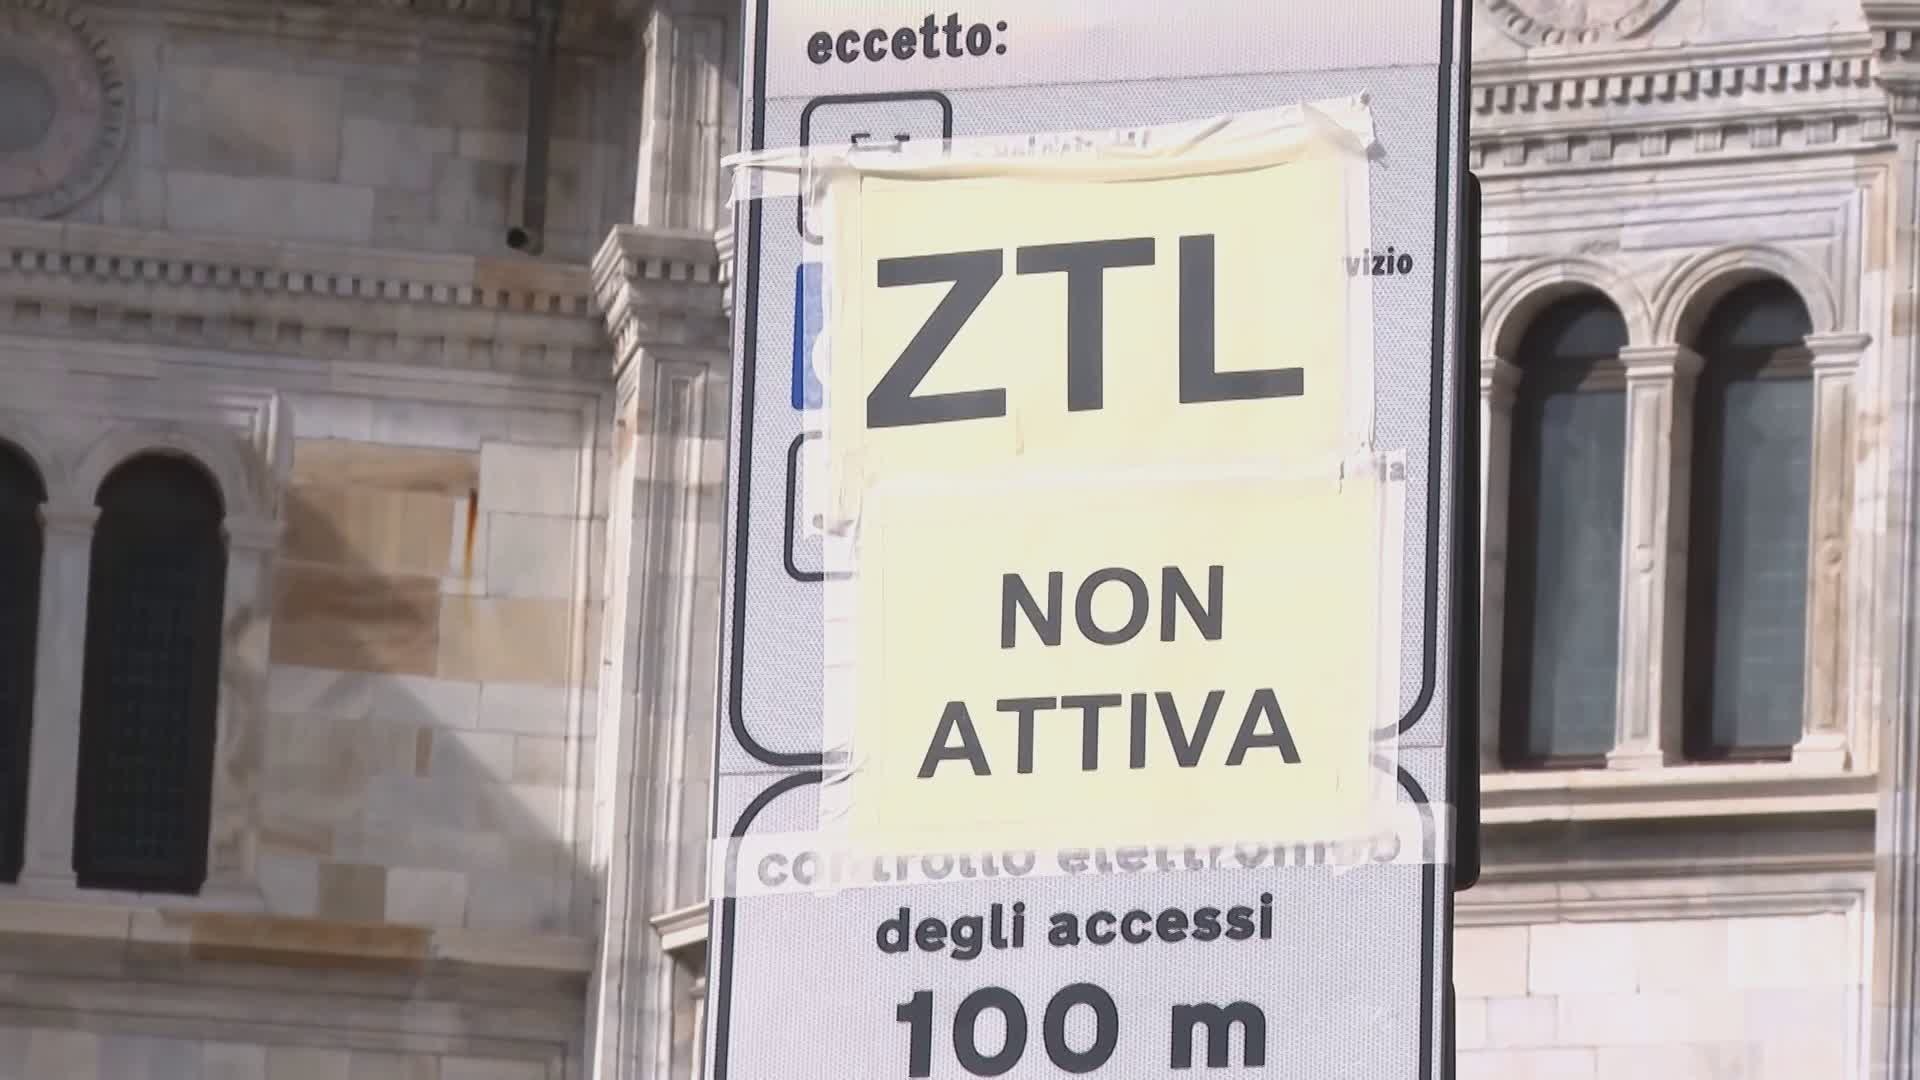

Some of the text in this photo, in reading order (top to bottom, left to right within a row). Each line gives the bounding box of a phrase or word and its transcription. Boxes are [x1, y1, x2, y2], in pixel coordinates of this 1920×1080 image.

[807, 12, 1008, 65] eccetto:
[1342, 246, 1413, 277] vizio
[866, 233, 1305, 429] ZTL
[1000, 564, 1225, 650] NON
[916, 688, 1302, 779] ATTIVA
[876, 891, 1274, 961] degli accessi
[895, 982, 1267, 1078] 100 m
